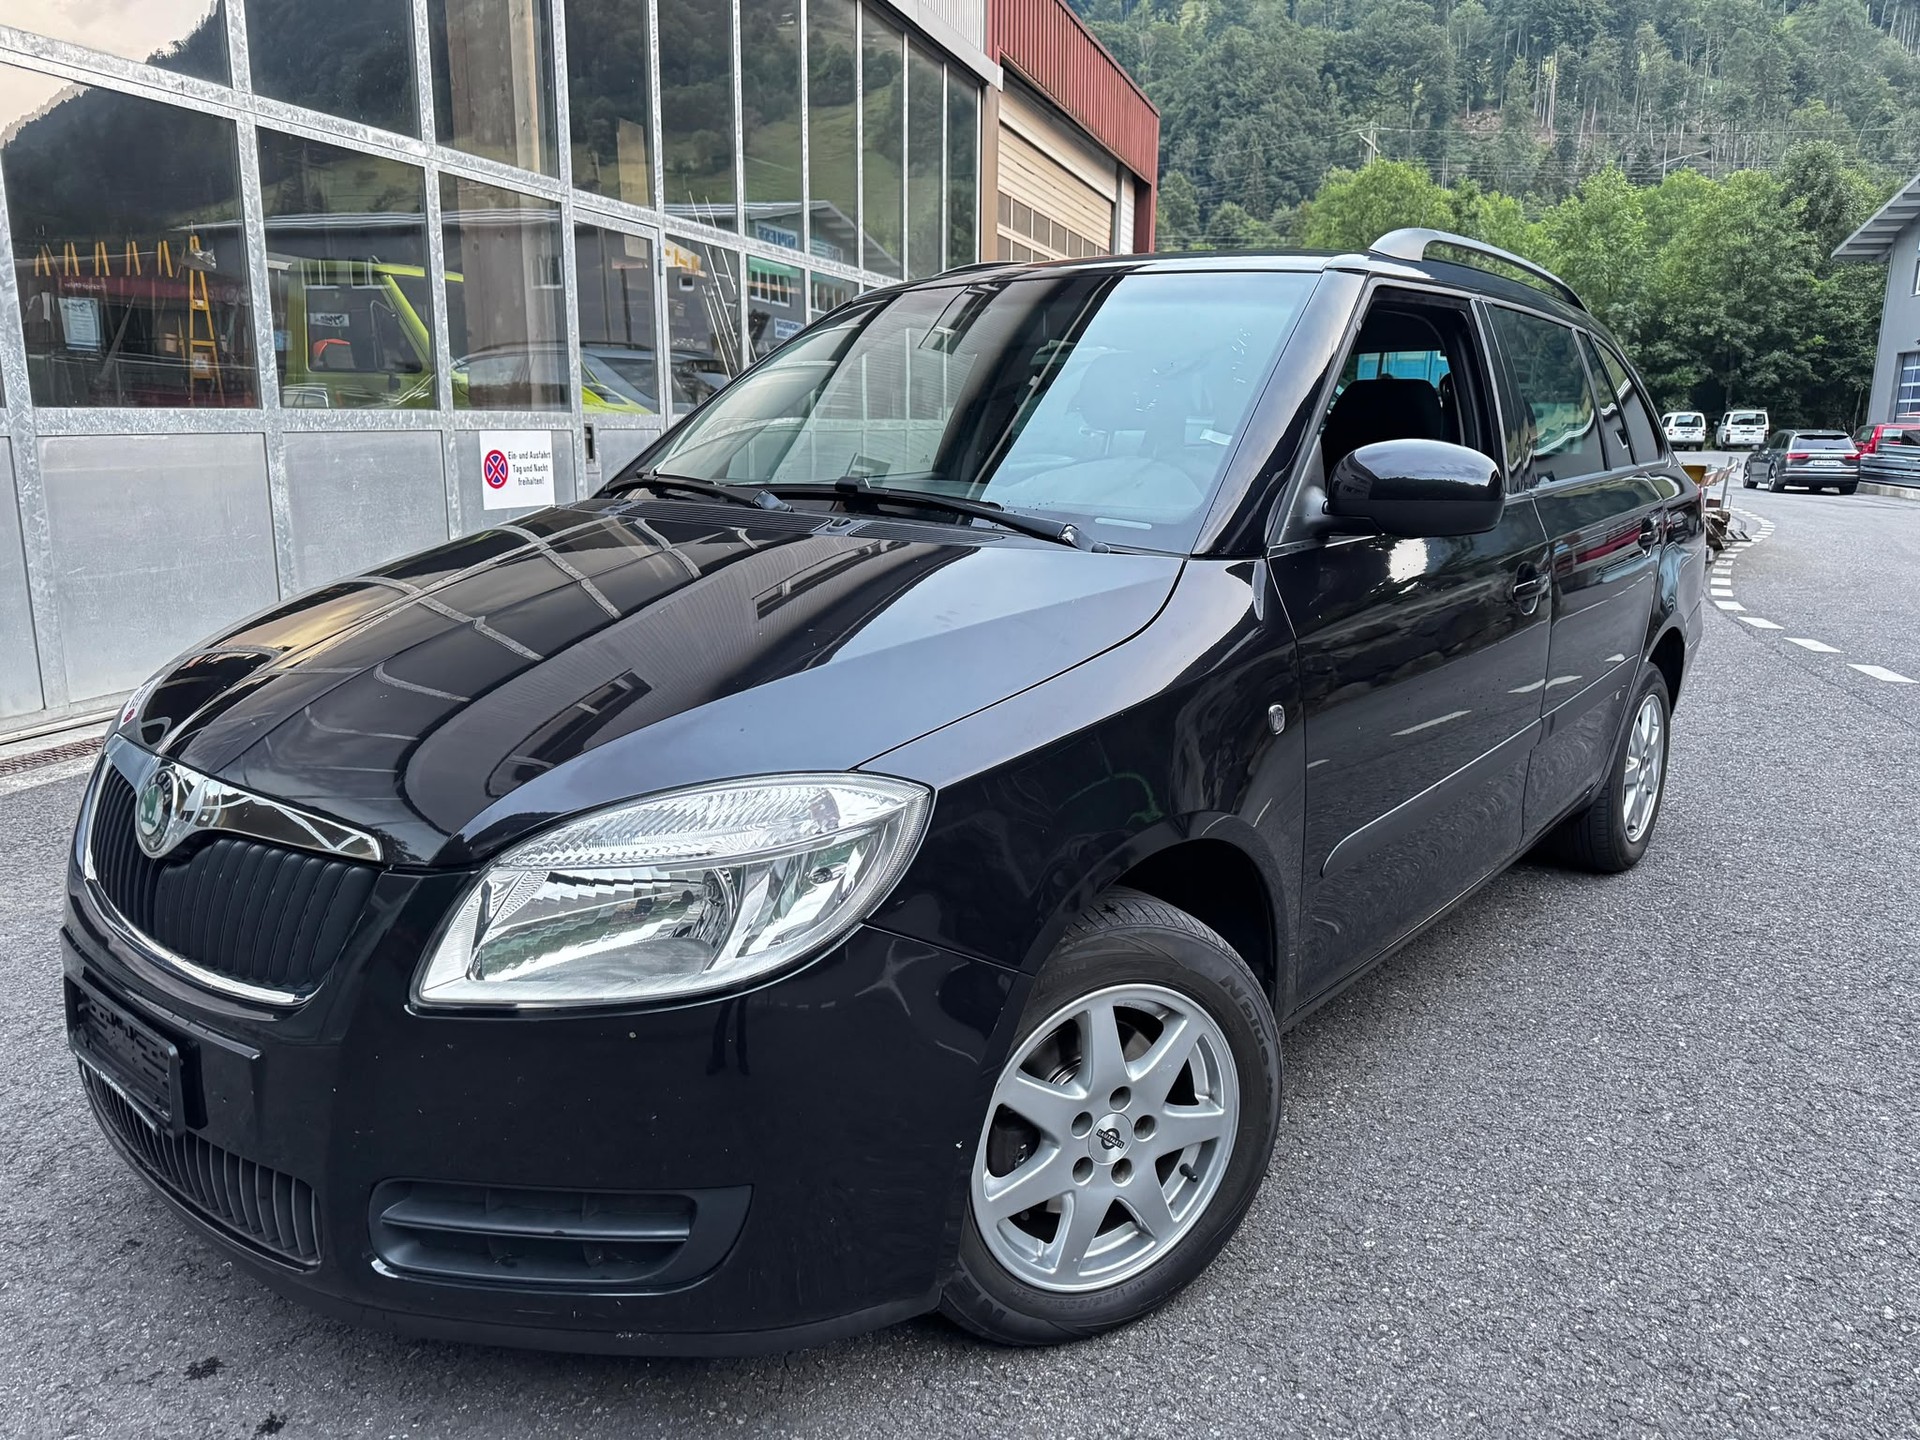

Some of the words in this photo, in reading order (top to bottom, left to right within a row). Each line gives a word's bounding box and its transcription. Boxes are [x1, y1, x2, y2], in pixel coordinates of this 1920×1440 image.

[519, 451, 528, 459] und
[530, 450, 551, 459] Ausfahrt
[513, 464, 522, 475] Tag
[523, 464, 532, 472] und
[534, 463, 549, 472] Nacht
[518, 476, 545, 486] freihalten!
